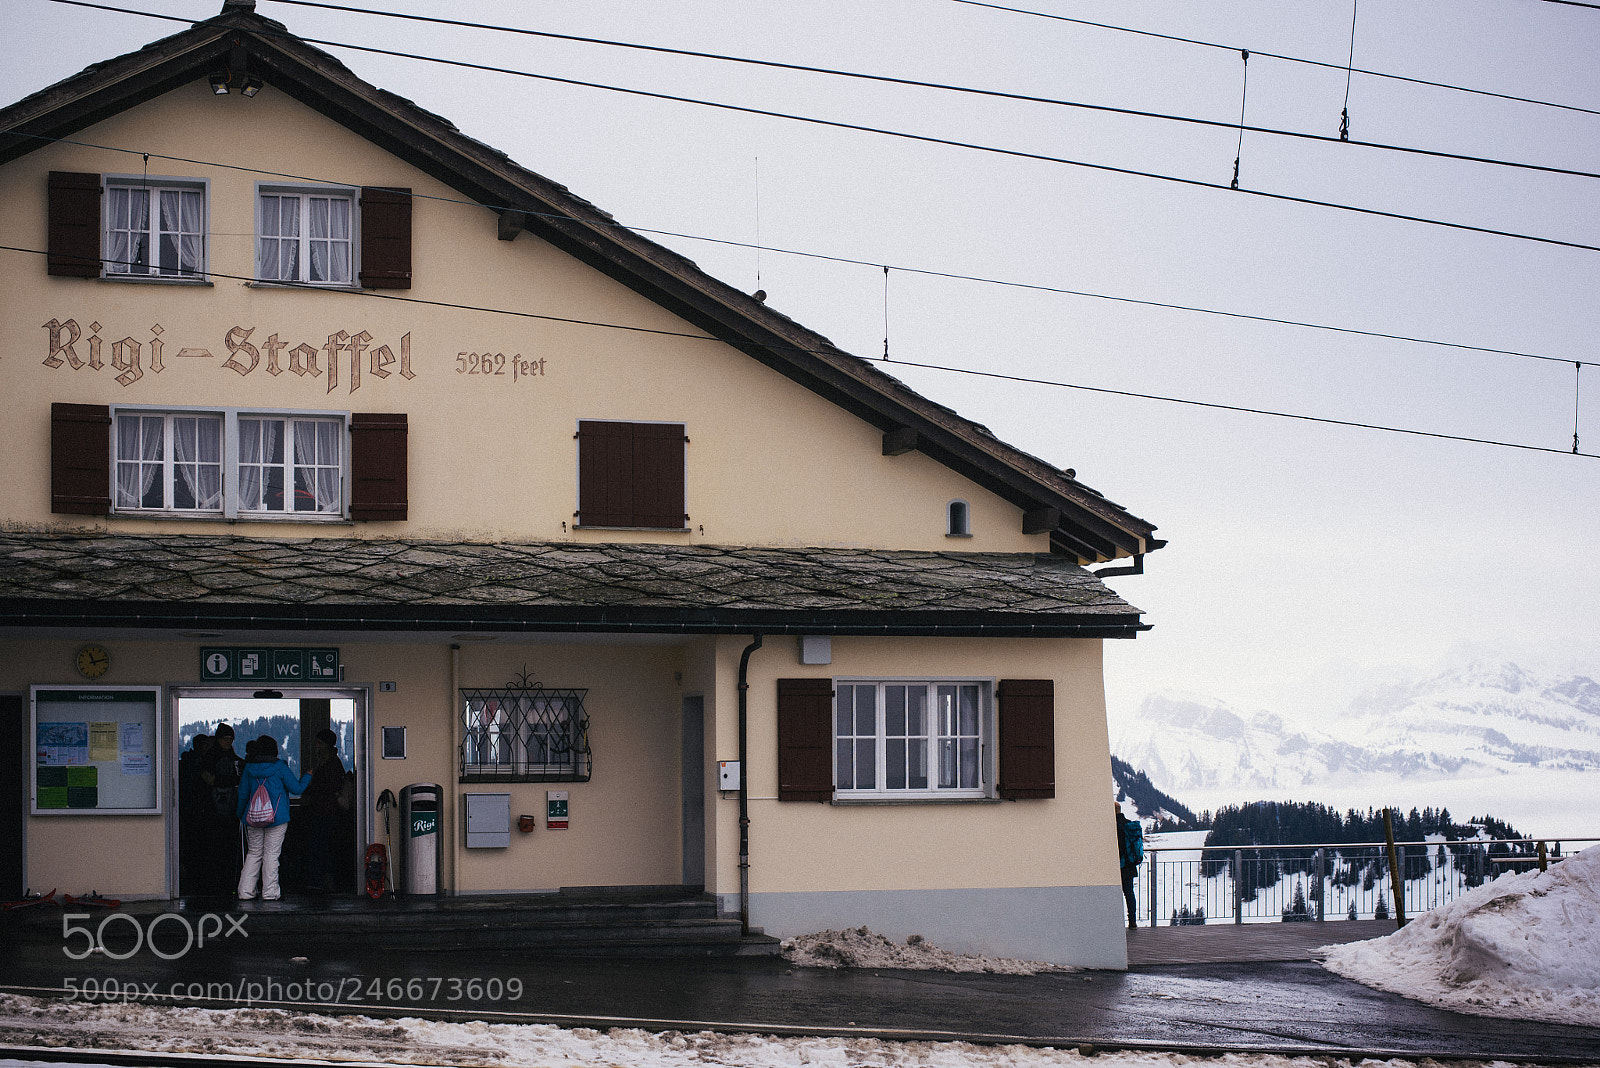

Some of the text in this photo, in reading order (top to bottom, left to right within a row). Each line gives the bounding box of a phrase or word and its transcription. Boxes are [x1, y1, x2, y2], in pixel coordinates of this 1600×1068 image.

[455, 351, 547, 383] 5262 feet
[276, 663, 300, 676] WC
[384, 683, 391, 691] 9
[413, 818, 435, 832] Rigi
